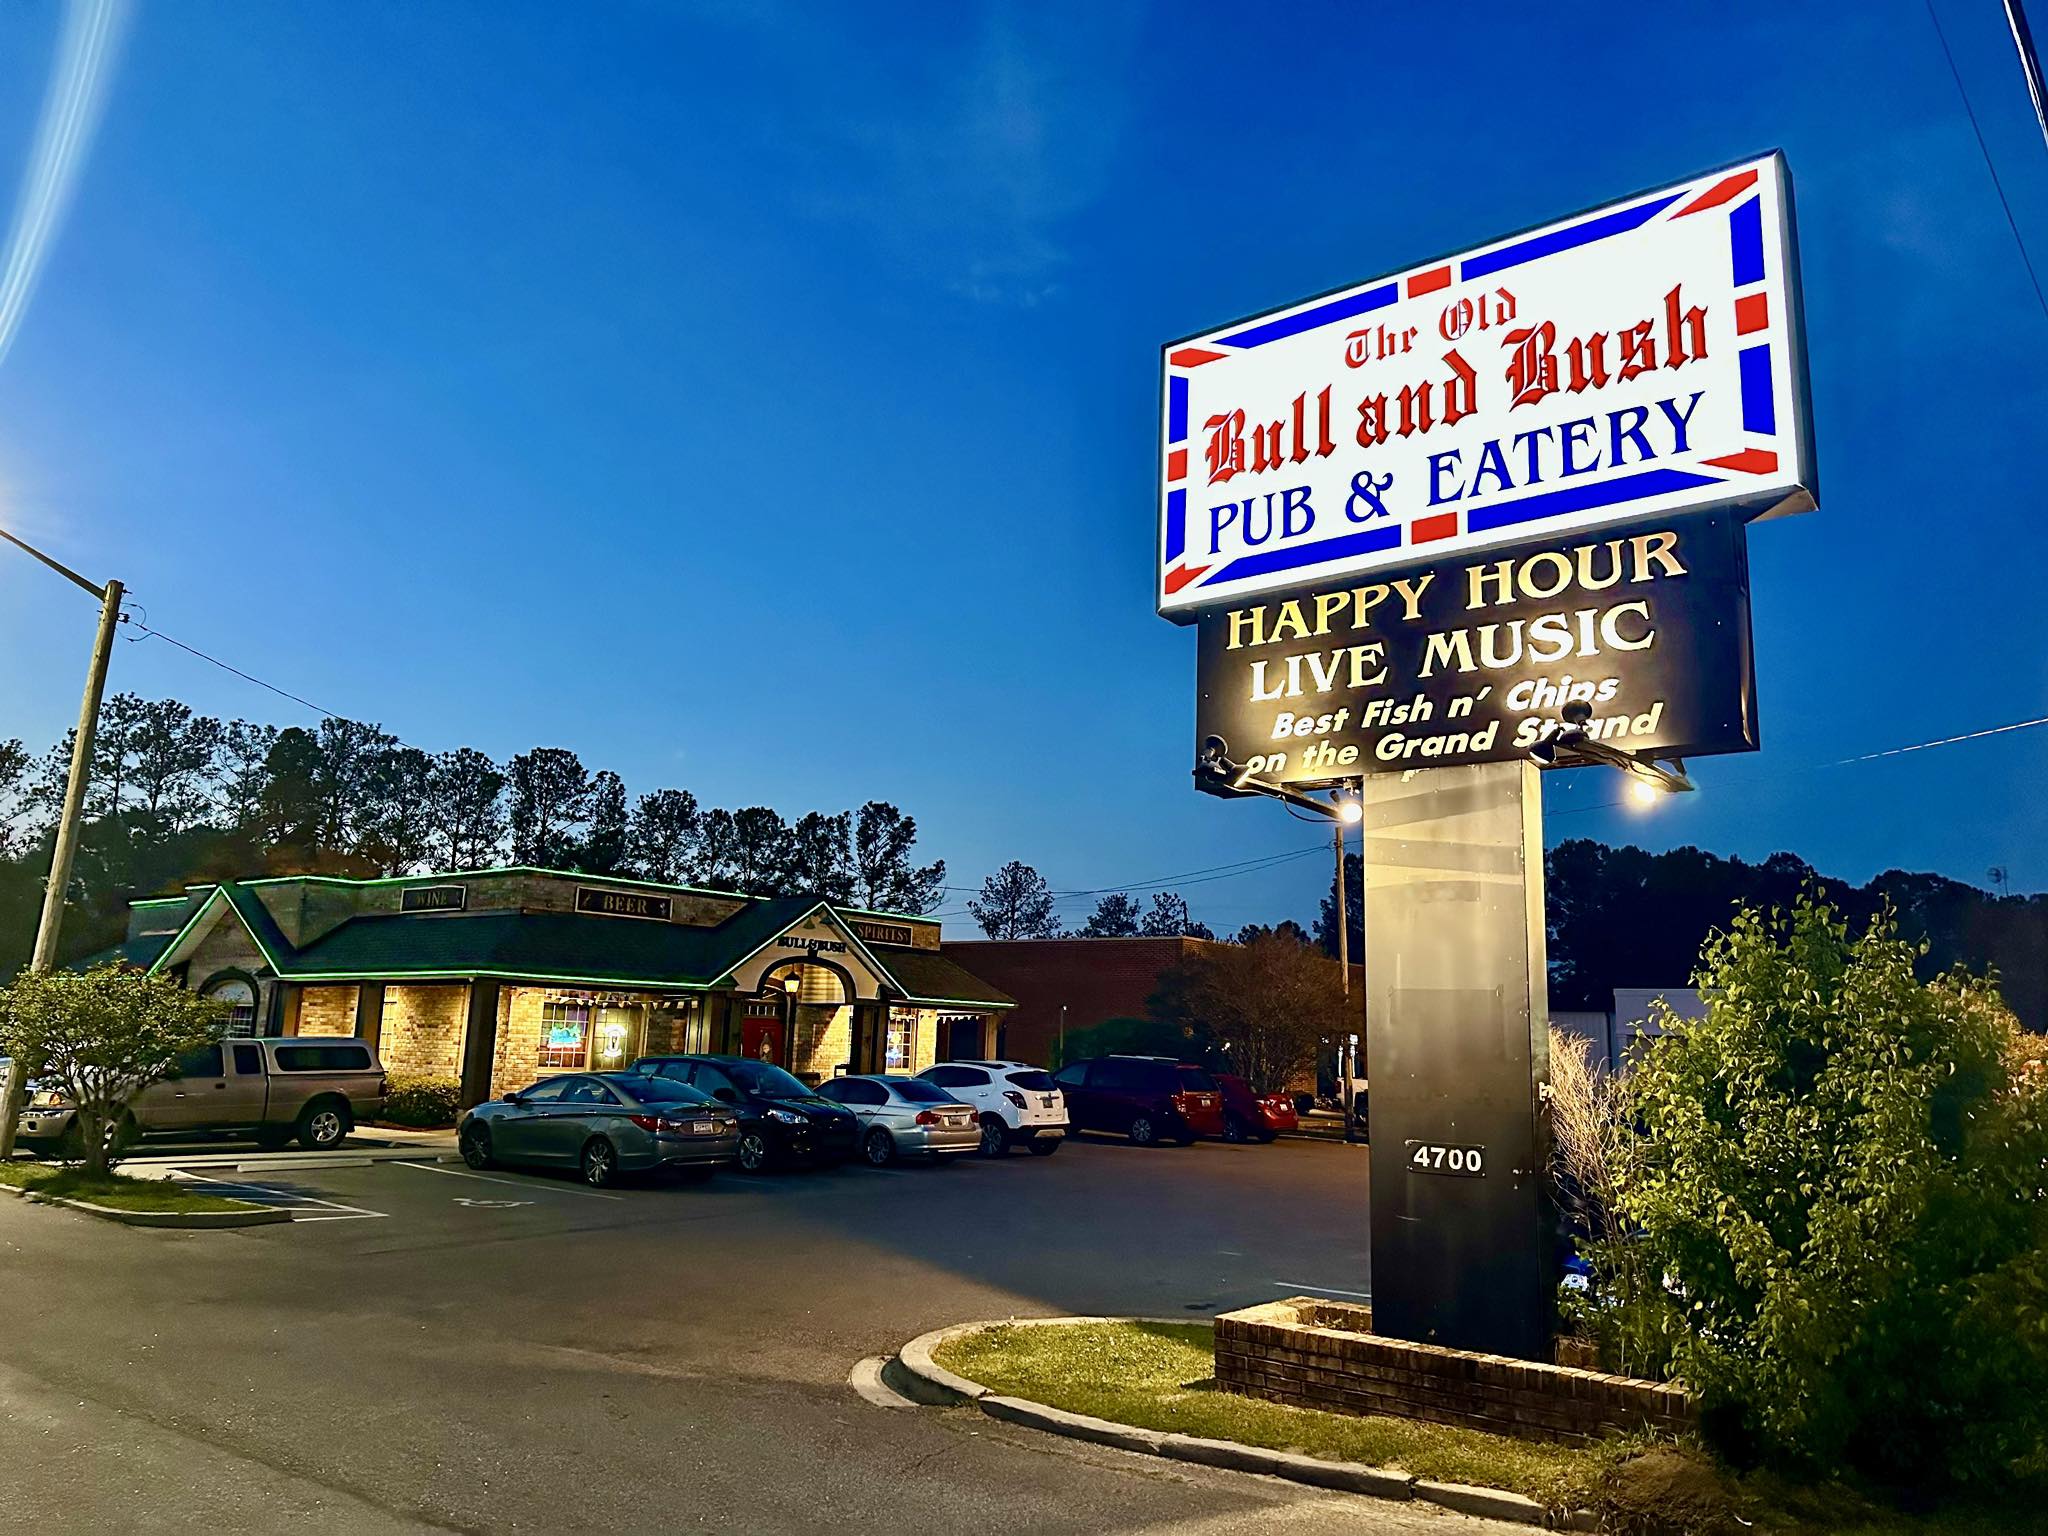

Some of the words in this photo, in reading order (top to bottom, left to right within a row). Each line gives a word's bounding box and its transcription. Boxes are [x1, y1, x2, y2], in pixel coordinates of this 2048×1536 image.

[1345, 323, 1418, 369] The
[1438, 287, 1518, 341] Old
[1203, 383, 1336, 486] Bull
[1354, 347, 1478, 448] and
[1500, 283, 1708, 412] Bush
[1208, 486, 1317, 556] PUB
[1345, 469, 1395, 523] &
[1426, 390, 1706, 508] EATERY
[1225, 573, 1436, 652] HAPPY
[1465, 530, 1687, 611] HOUR
[1249, 641, 1388, 705] LIVE
[1417, 600, 1656, 680] MUSIC
[1271, 707, 1350, 741] Best
[1362, 693, 1434, 729] Fish
[1505, 672, 1620, 714] Chips
[1247, 751, 1288, 776] on
[1300, 739, 1360, 770] the
[1376, 720, 1500, 762] Grand
[603, 895, 648, 914] BEER
[858, 924, 904, 942] SPIRITS
[1413, 1146, 1482, 1172] 4700
